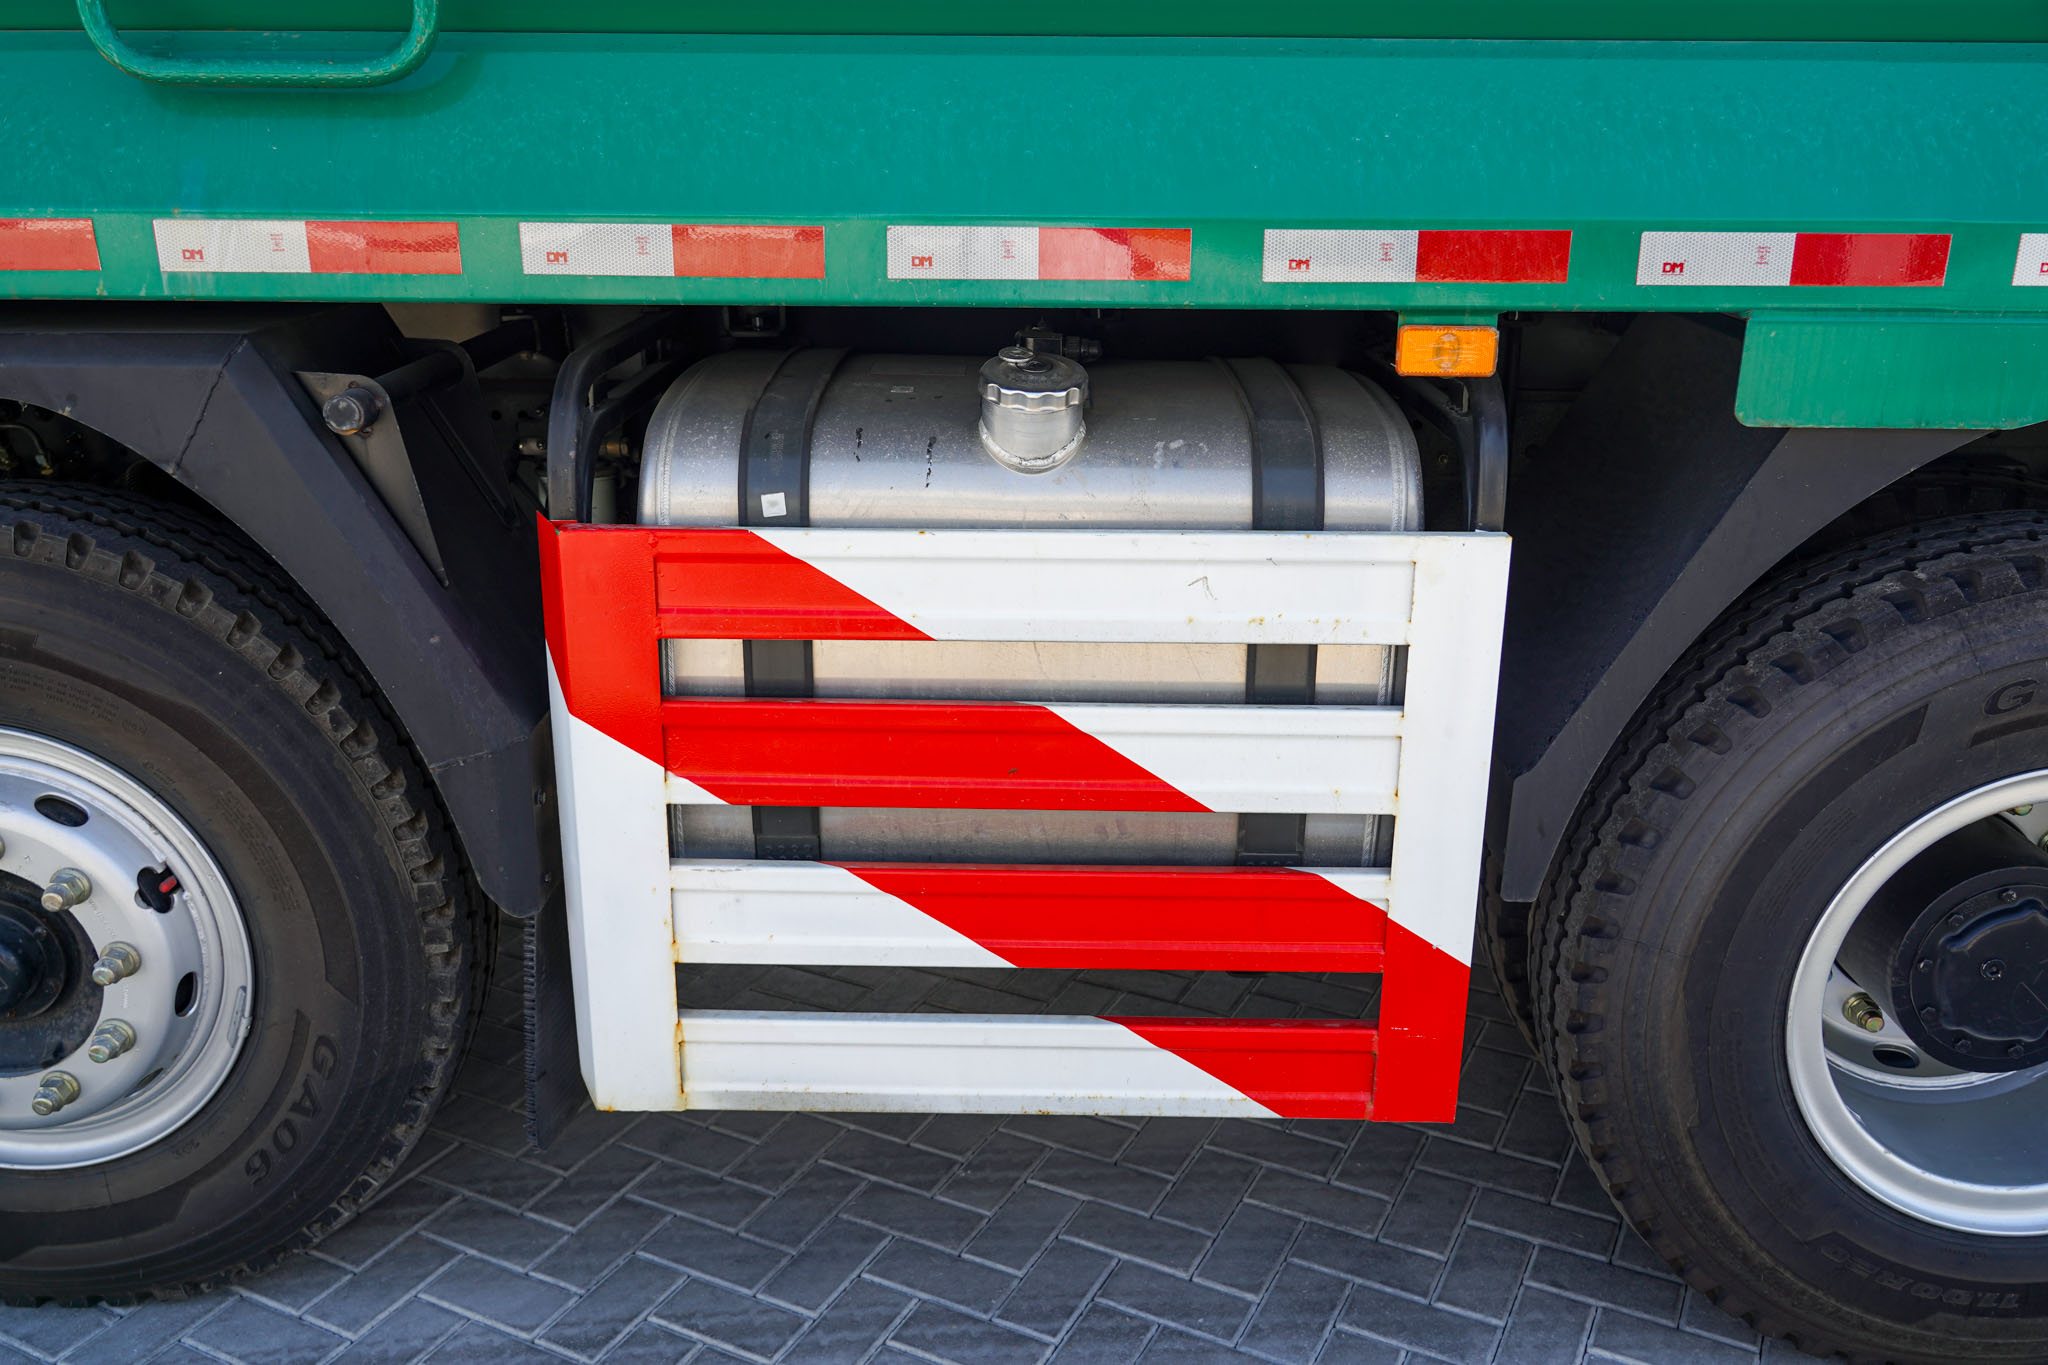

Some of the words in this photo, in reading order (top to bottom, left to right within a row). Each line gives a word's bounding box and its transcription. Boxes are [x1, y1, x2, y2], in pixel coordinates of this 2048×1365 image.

[182, 249, 204, 260] DM
[546, 252, 568, 264] DM
[912, 256, 933, 267] DM
[1289, 259, 1310, 271] DM
[1662, 262, 1684, 273] DM
[245, 1034, 338, 1185] GA06
